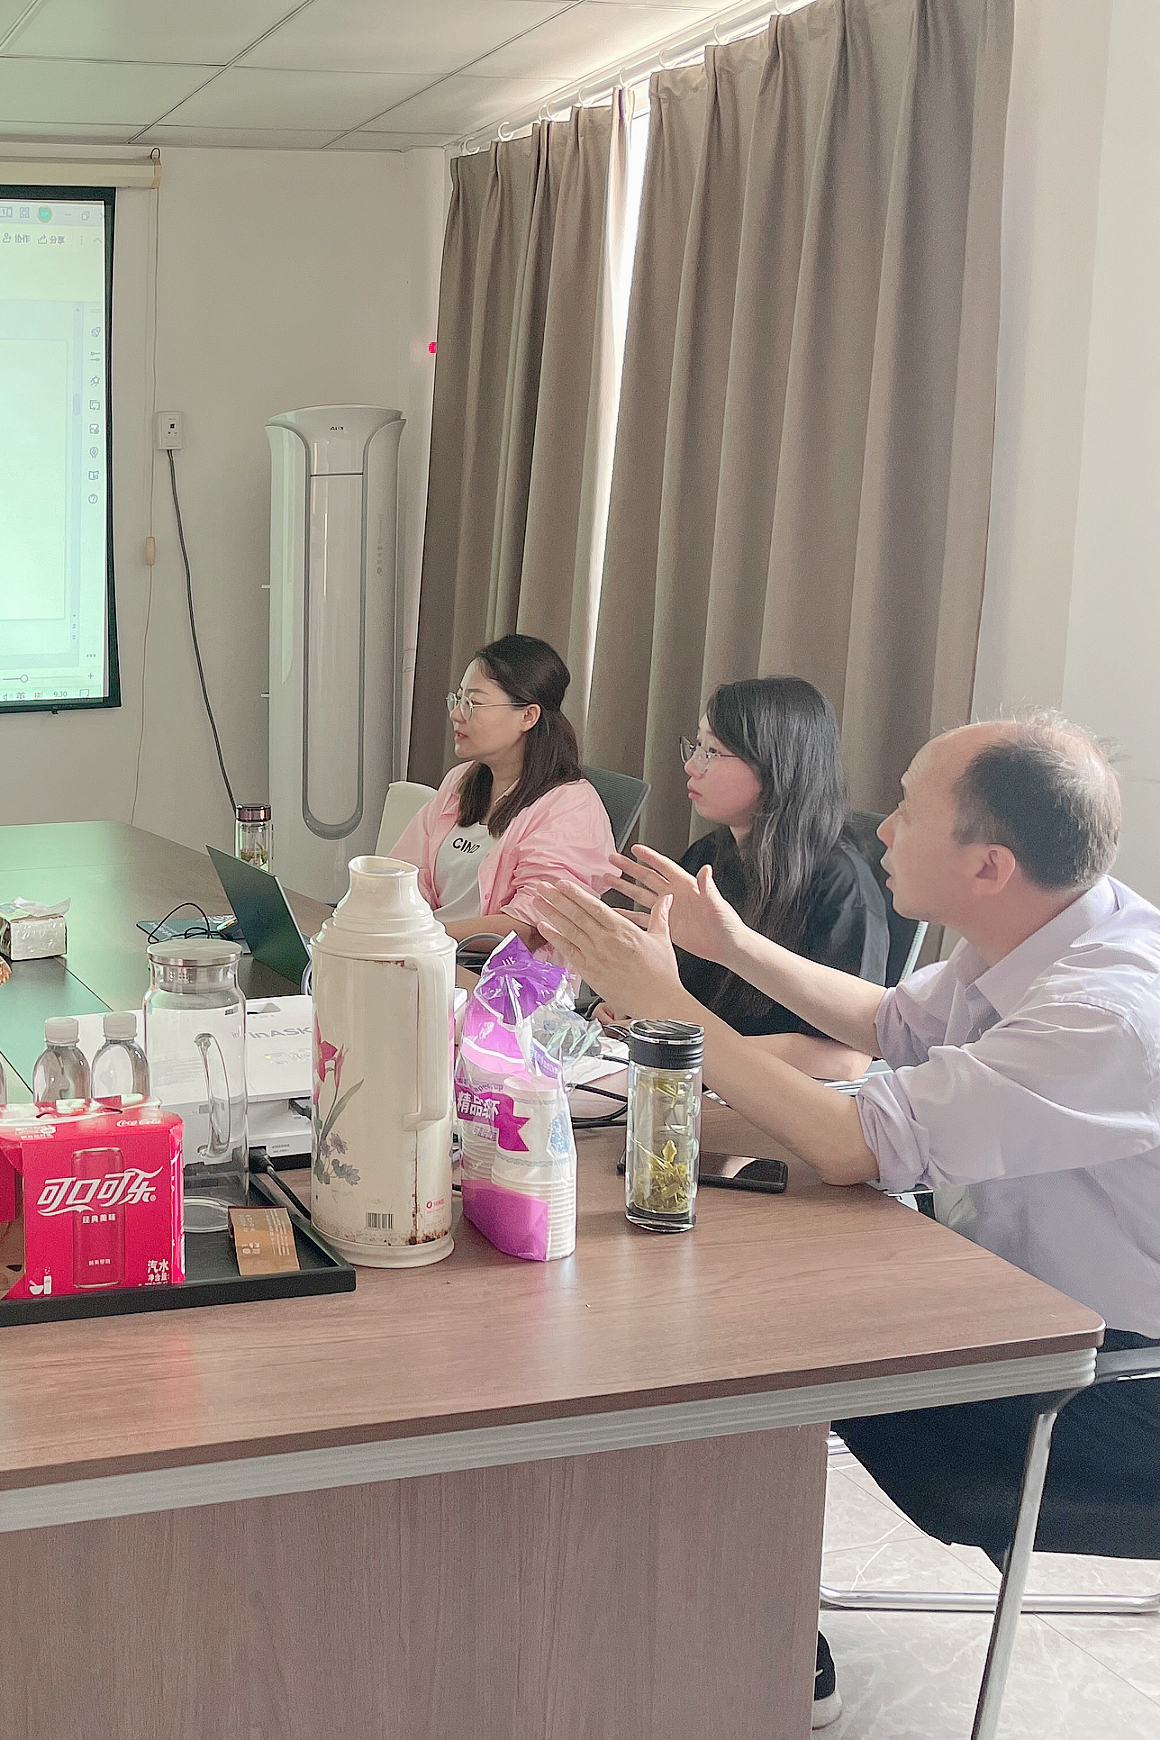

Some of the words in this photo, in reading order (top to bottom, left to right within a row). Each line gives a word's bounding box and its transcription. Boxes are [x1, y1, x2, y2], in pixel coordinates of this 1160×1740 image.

[14, 234, 31, 244] 协作
[49, 235, 66, 245] 分享
[36, 1165, 163, 1217] 可口可乐
[147, 1258, 169, 1274] 汽水
